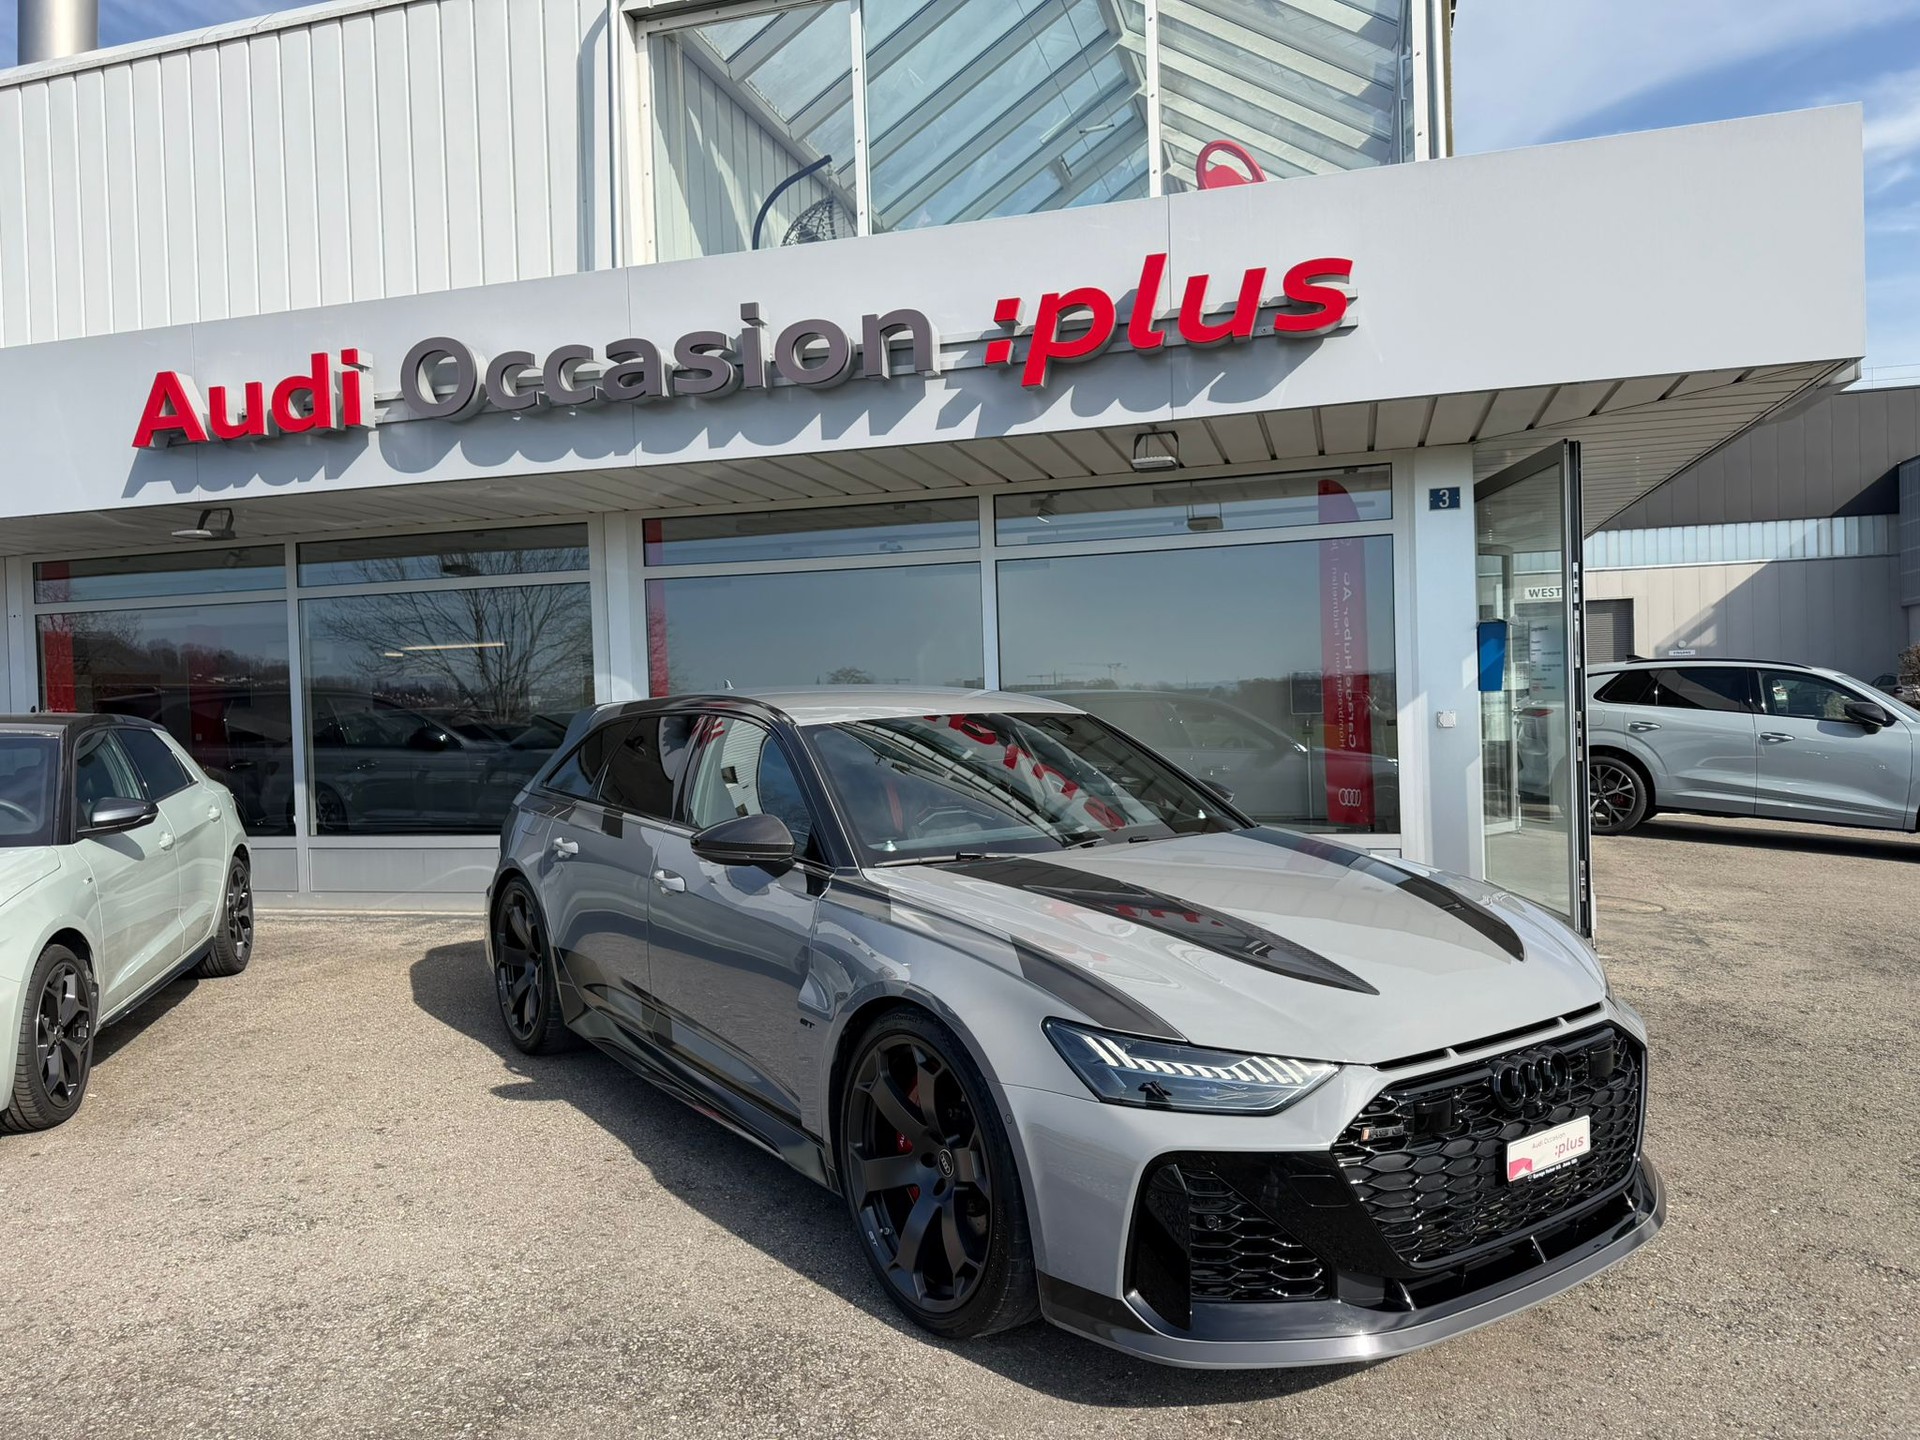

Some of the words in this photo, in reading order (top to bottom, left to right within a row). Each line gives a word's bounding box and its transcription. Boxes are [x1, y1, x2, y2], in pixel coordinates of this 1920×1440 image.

[132, 348, 360, 449] Audi
[401, 302, 936, 419] Occasion
[984, 253, 1354, 388] :plus
[1438, 489, 1450, 508] 3
[1528, 587, 1562, 598] WEST
